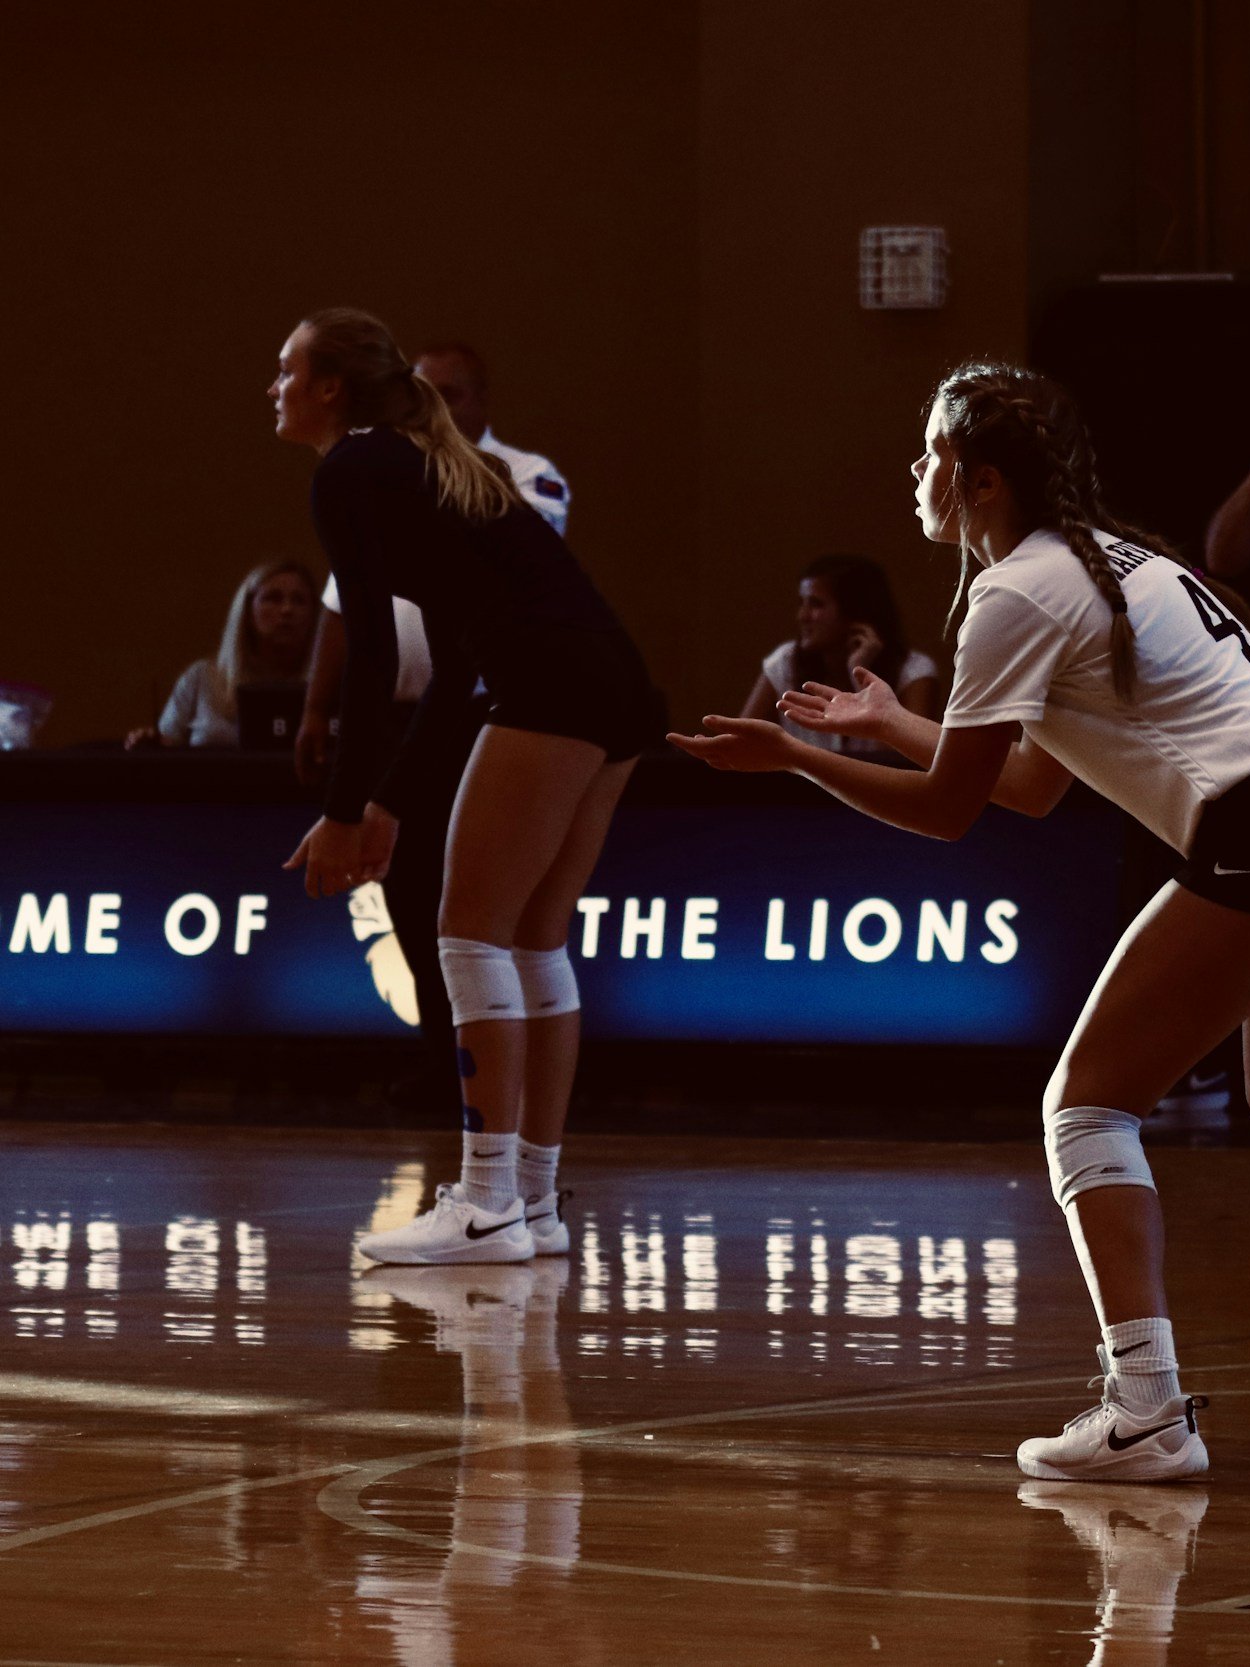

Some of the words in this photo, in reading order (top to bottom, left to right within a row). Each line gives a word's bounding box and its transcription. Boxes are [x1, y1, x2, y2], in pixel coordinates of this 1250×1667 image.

[8, 892, 122, 955] ME
[163, 892, 269, 957] OF
[576, 896, 719, 961] THE
[763, 897, 1019, 964] LIONS
